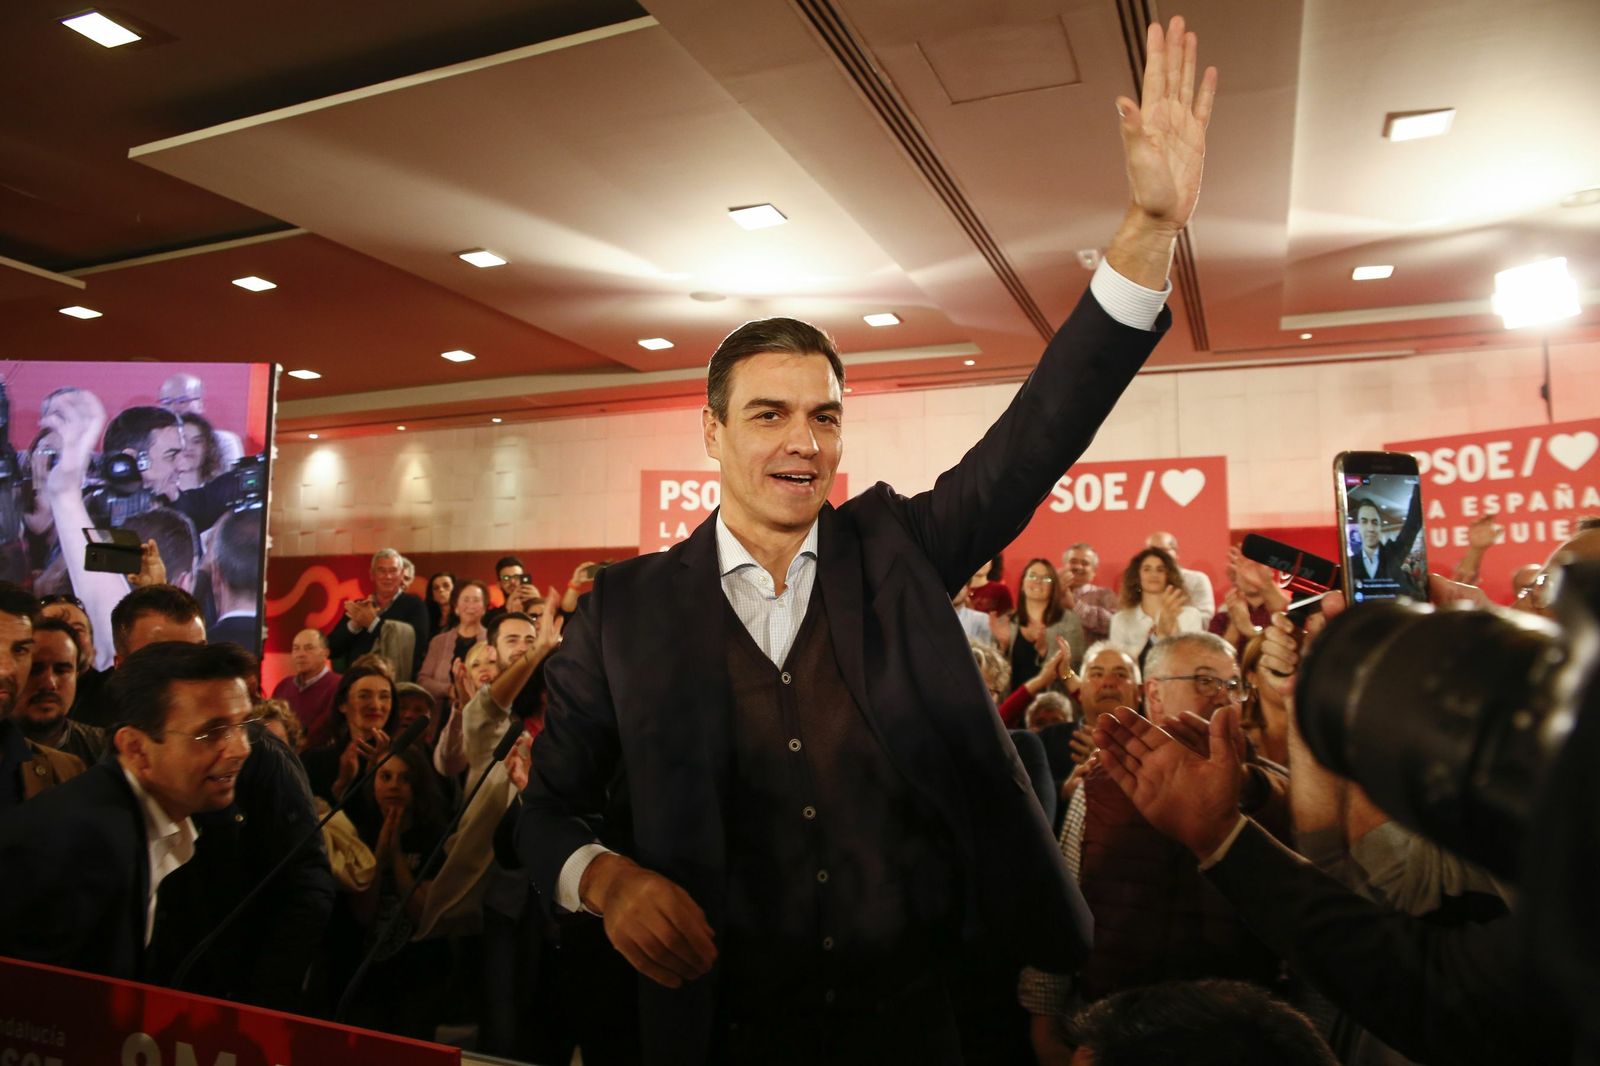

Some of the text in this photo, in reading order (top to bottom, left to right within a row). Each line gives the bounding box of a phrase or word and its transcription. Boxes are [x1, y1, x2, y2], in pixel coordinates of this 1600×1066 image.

[659, 480, 720, 511] PSO
[1050, 472, 1128, 513] SOE
[1428, 483, 1600, 519] A ESPAÑA
[659, 521, 690, 539] LA
[1430, 518, 1571, 548] UE UIE
